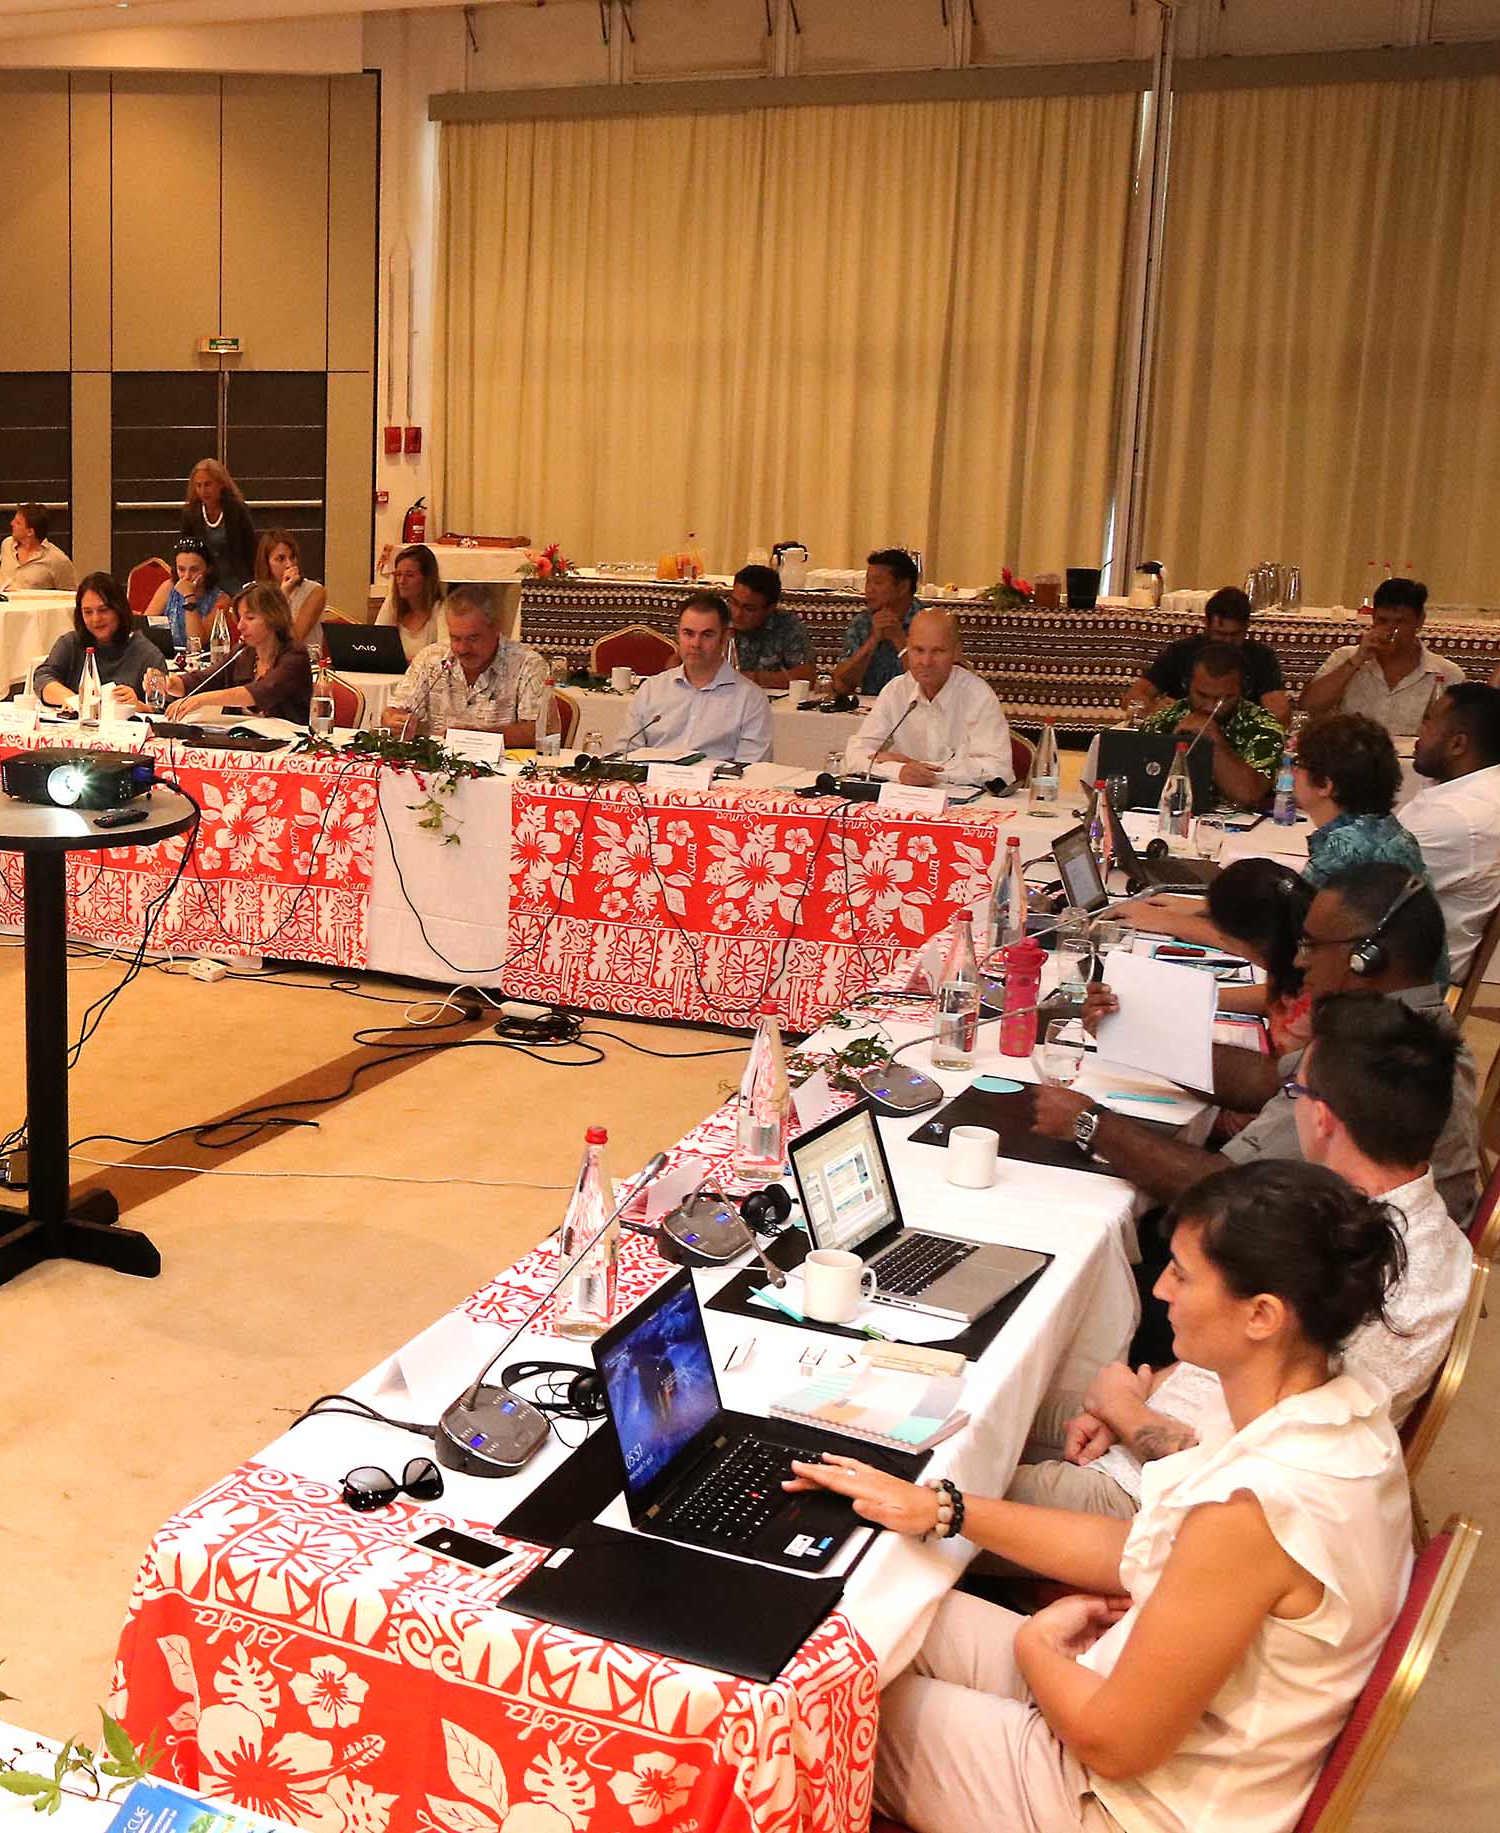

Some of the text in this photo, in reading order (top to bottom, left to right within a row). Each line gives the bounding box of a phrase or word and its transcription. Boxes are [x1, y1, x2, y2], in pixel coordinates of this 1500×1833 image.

[221, 771, 252, 786] Talofa
[601, 803, 641, 821] Samoa
[716, 811, 759, 829] Samoa
[516, 895, 553, 914] Talofa
[624, 908, 664, 928] Talofa
[737, 920, 780, 938] Talofa
[858, 929, 900, 946] Talofa
[191, 1608, 298, 1672] Talofa
[501, 1701, 621, 1771] Talofa
